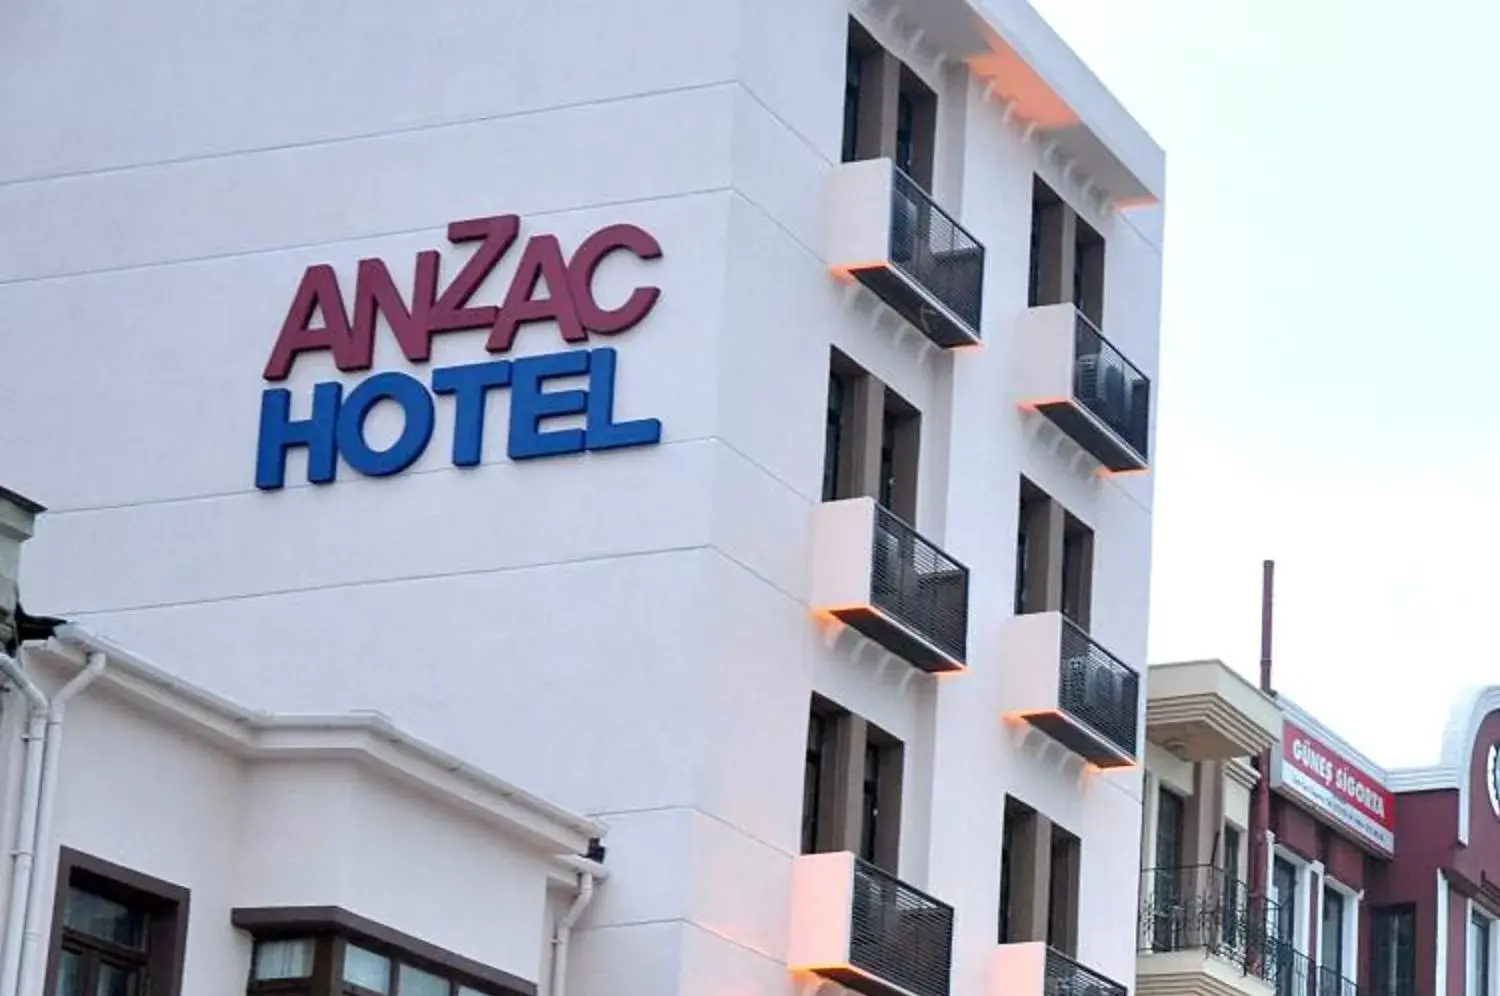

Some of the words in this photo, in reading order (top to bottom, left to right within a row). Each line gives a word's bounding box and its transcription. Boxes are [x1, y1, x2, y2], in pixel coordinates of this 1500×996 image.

[263, 213, 663, 381] ANZAC
[255, 346, 663, 491] HOTEL
[1292, 738, 1333, 786] GÜNEŞ
